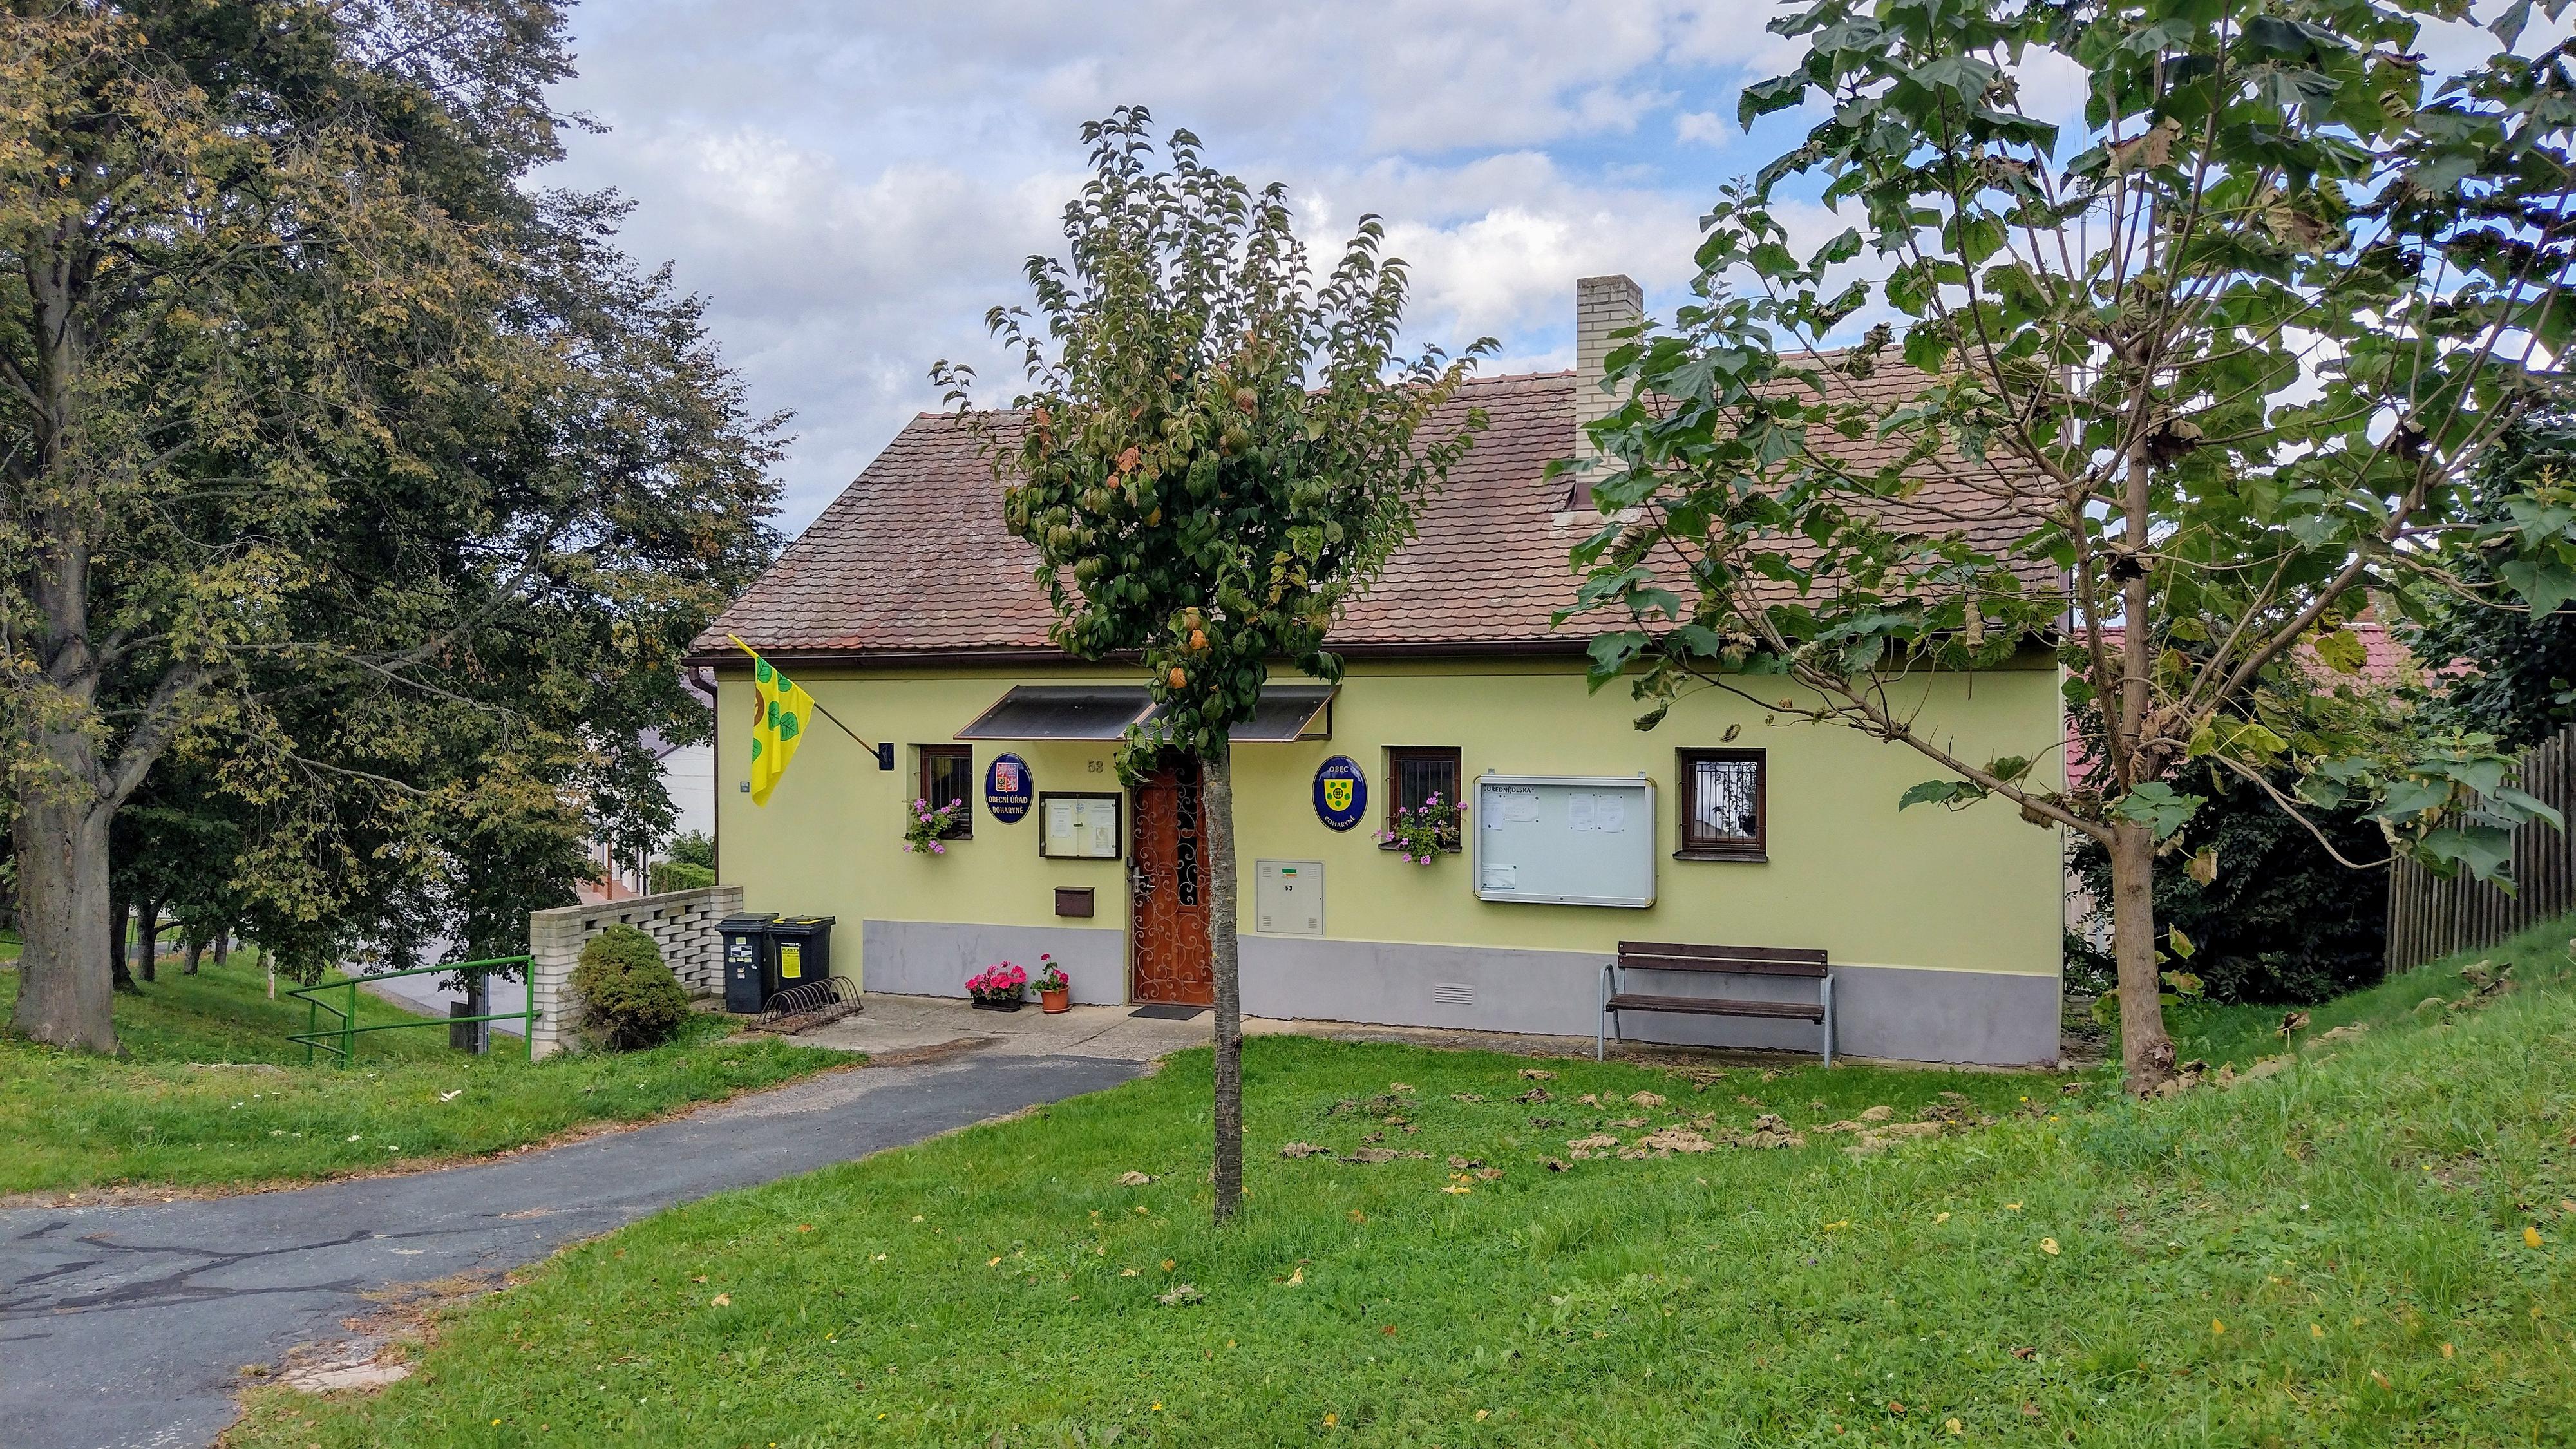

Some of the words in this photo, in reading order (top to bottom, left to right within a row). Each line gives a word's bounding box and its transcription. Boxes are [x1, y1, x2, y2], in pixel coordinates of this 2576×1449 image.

[1088, 761, 1103, 773] 53
[988, 795, 1009, 804] OBECNÍ
[1010, 795, 1028, 804] ÚŘAD
[992, 805, 1023, 814] BOHARYNĚ
[1324, 815, 1356, 828] BOHARYNĚ
